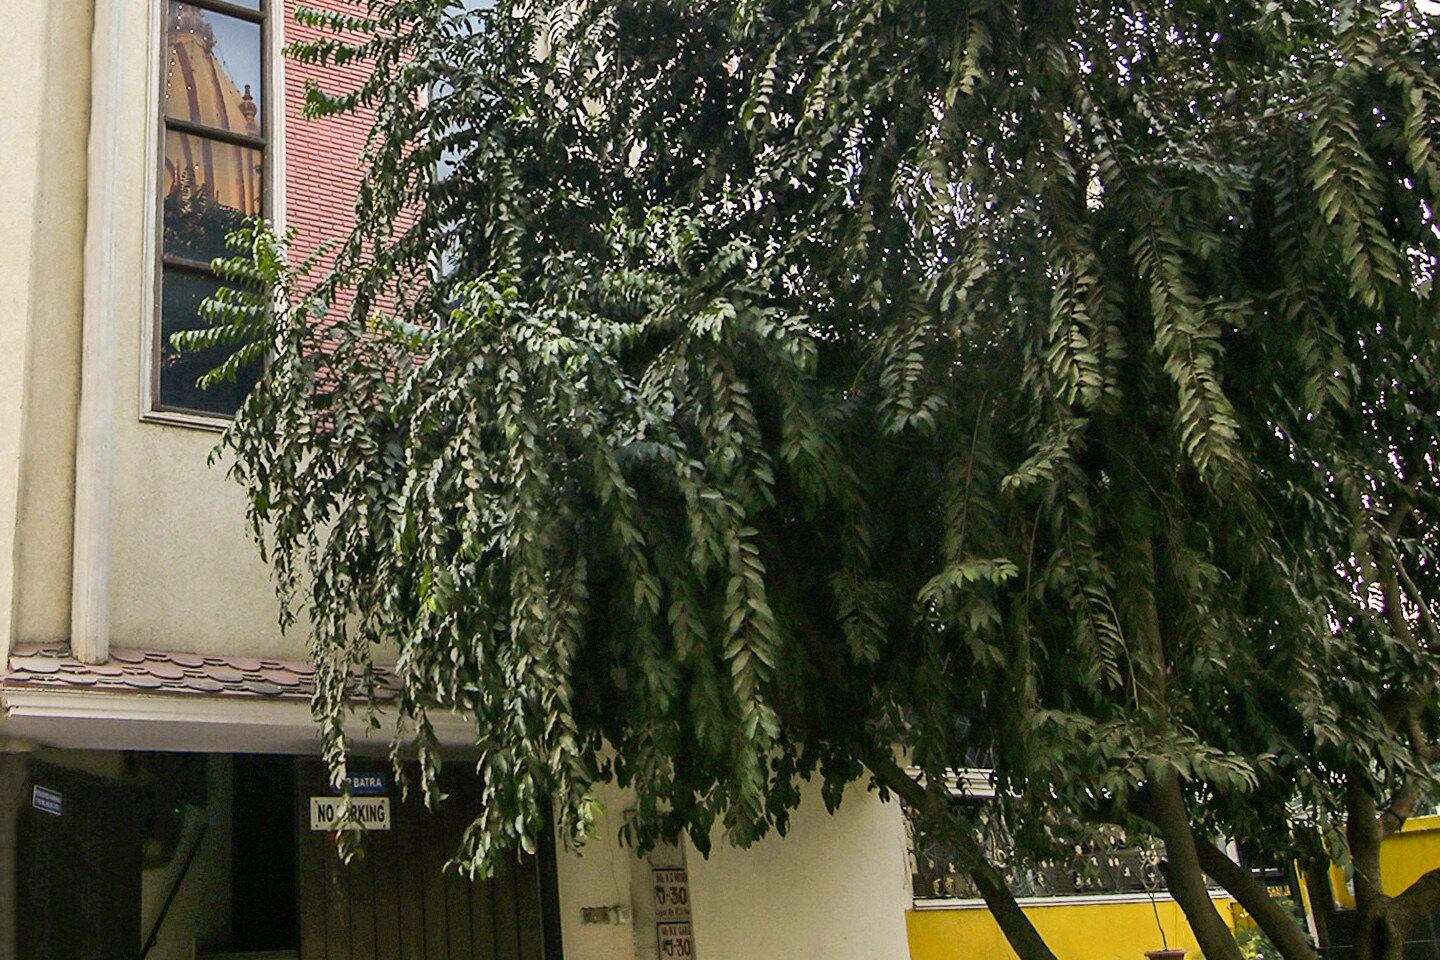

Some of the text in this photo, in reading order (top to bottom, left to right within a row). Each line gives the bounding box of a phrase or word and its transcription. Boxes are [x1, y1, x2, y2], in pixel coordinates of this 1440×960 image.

[353, 777, 382, 788] BATRA
[318, 804, 385, 822] NO ARKING
